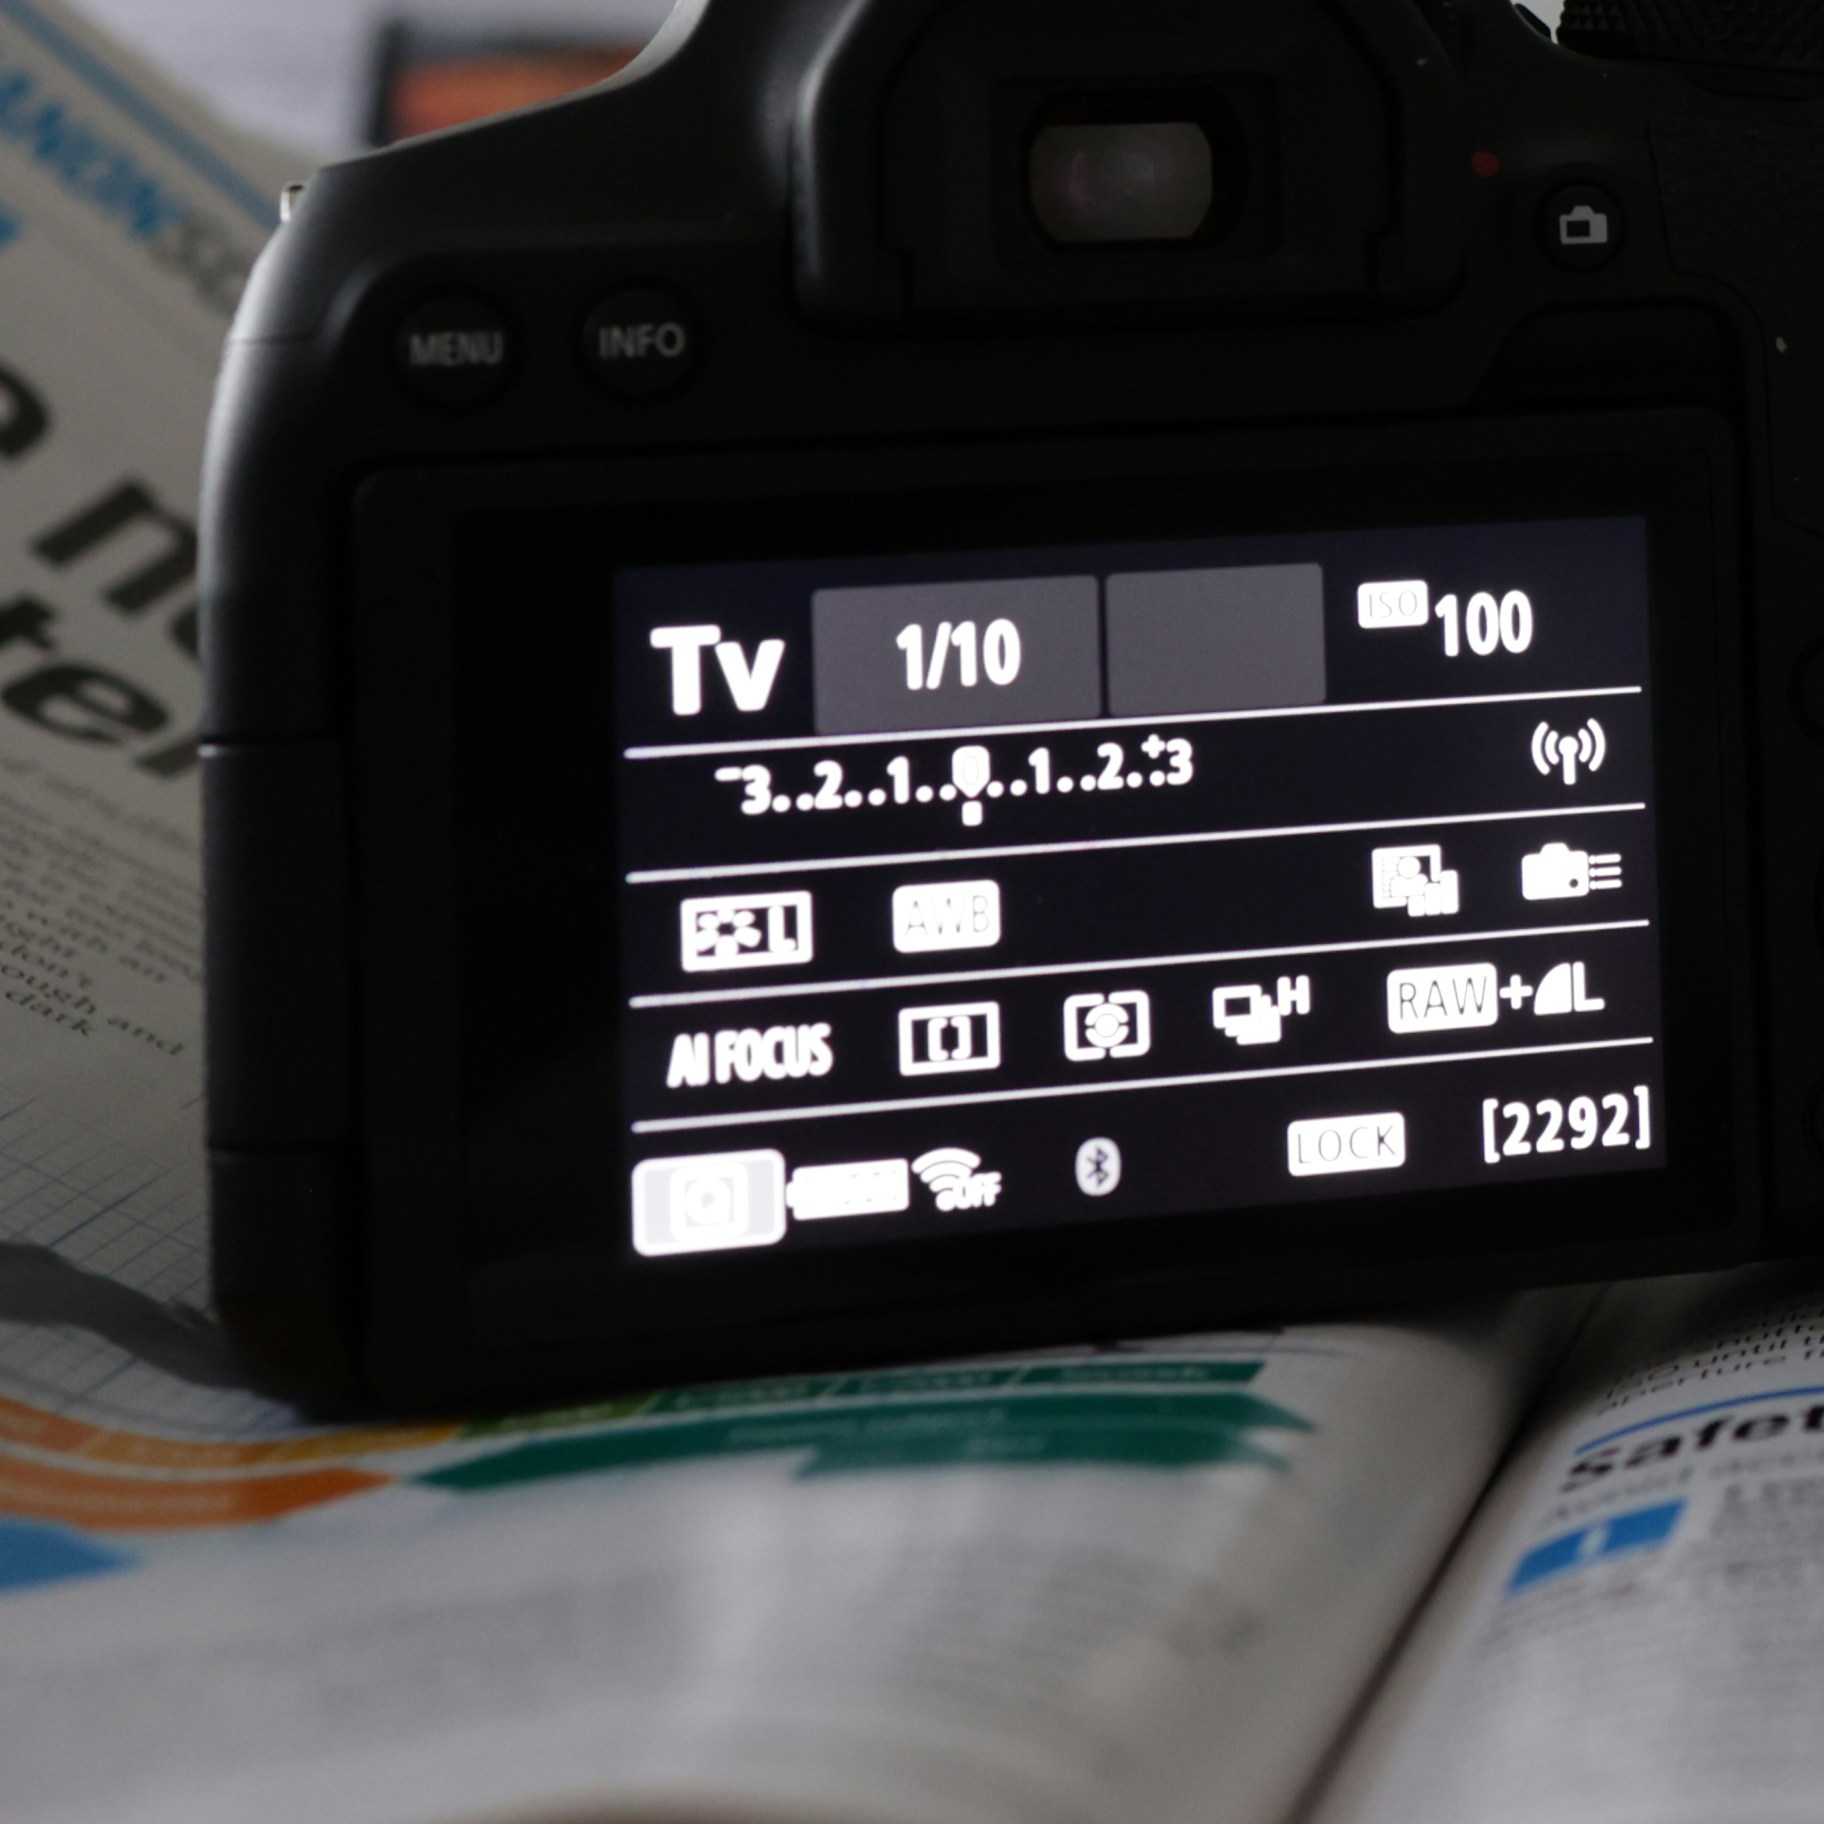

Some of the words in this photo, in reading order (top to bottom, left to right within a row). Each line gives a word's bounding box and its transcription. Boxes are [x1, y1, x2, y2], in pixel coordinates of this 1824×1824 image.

[409, 332, 503, 367] MENU
[597, 322, 685, 361] INFO
[1367, 590, 1418, 619] ISO
[1435, 590, 1533, 658] 100
[650, 624, 785, 716] Tv
[896, 618, 1021, 690] 1/10
[903, 893, 990, 938] AWB
[1397, 975, 1489, 1022] RAW
[667, 1032, 709, 1088] AI
[714, 1022, 834, 1084] FOCUS
[1296, 1123, 1398, 1166] LOCK
[1482, 1084, 1651, 1164] [2292]
